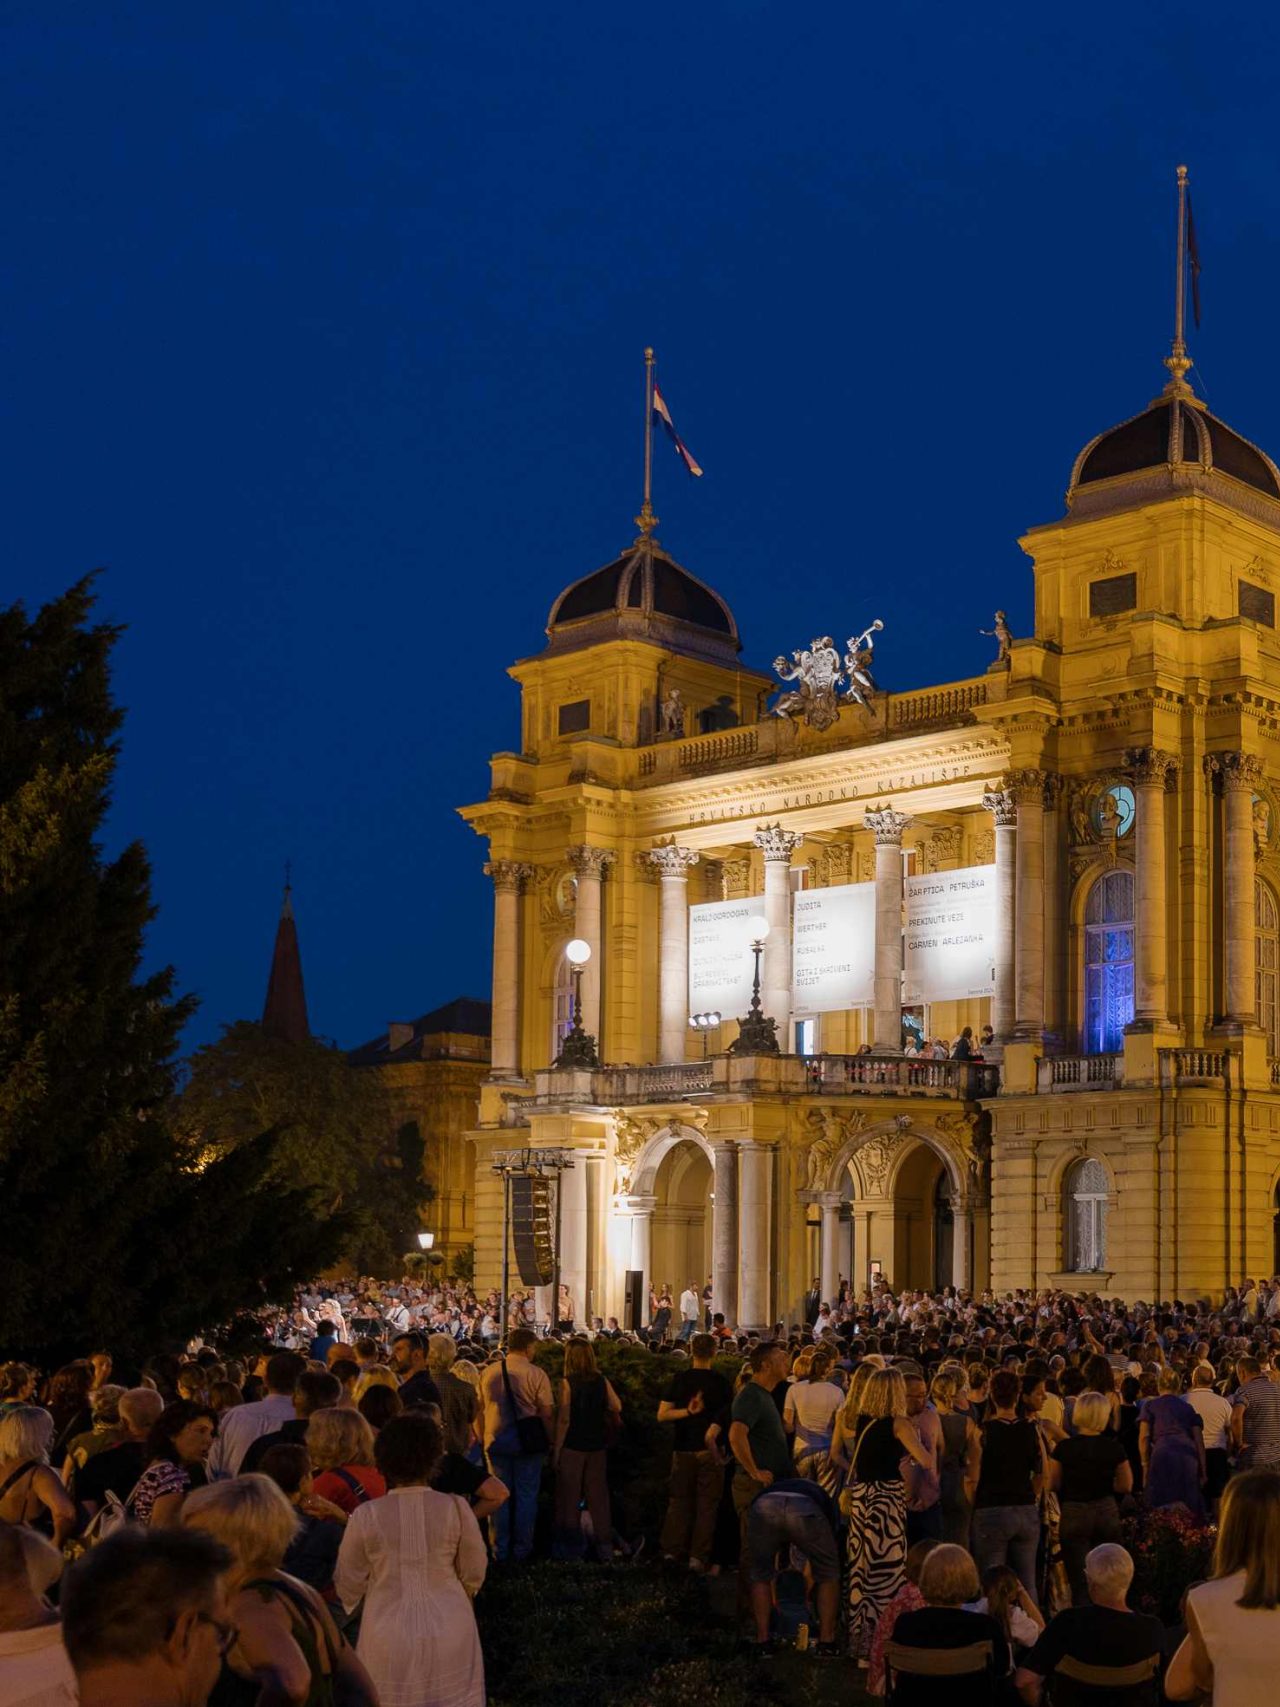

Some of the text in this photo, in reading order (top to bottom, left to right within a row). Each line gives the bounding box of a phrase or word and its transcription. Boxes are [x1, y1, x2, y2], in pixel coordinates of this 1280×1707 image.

[689, 766, 970, 826] HRVATSKO NARODNO KAZALIŠTE
[923, 885, 945, 896] PTICA
[949, 879, 985, 892] PETRUŠKA
[797, 901, 821, 912] JUDITA
[908, 914, 946, 928] PREKINUTE
[797, 922, 827, 933] WERTHER
[908, 939, 938, 950] CARMEN
[796, 976, 820, 987] SVIJET
